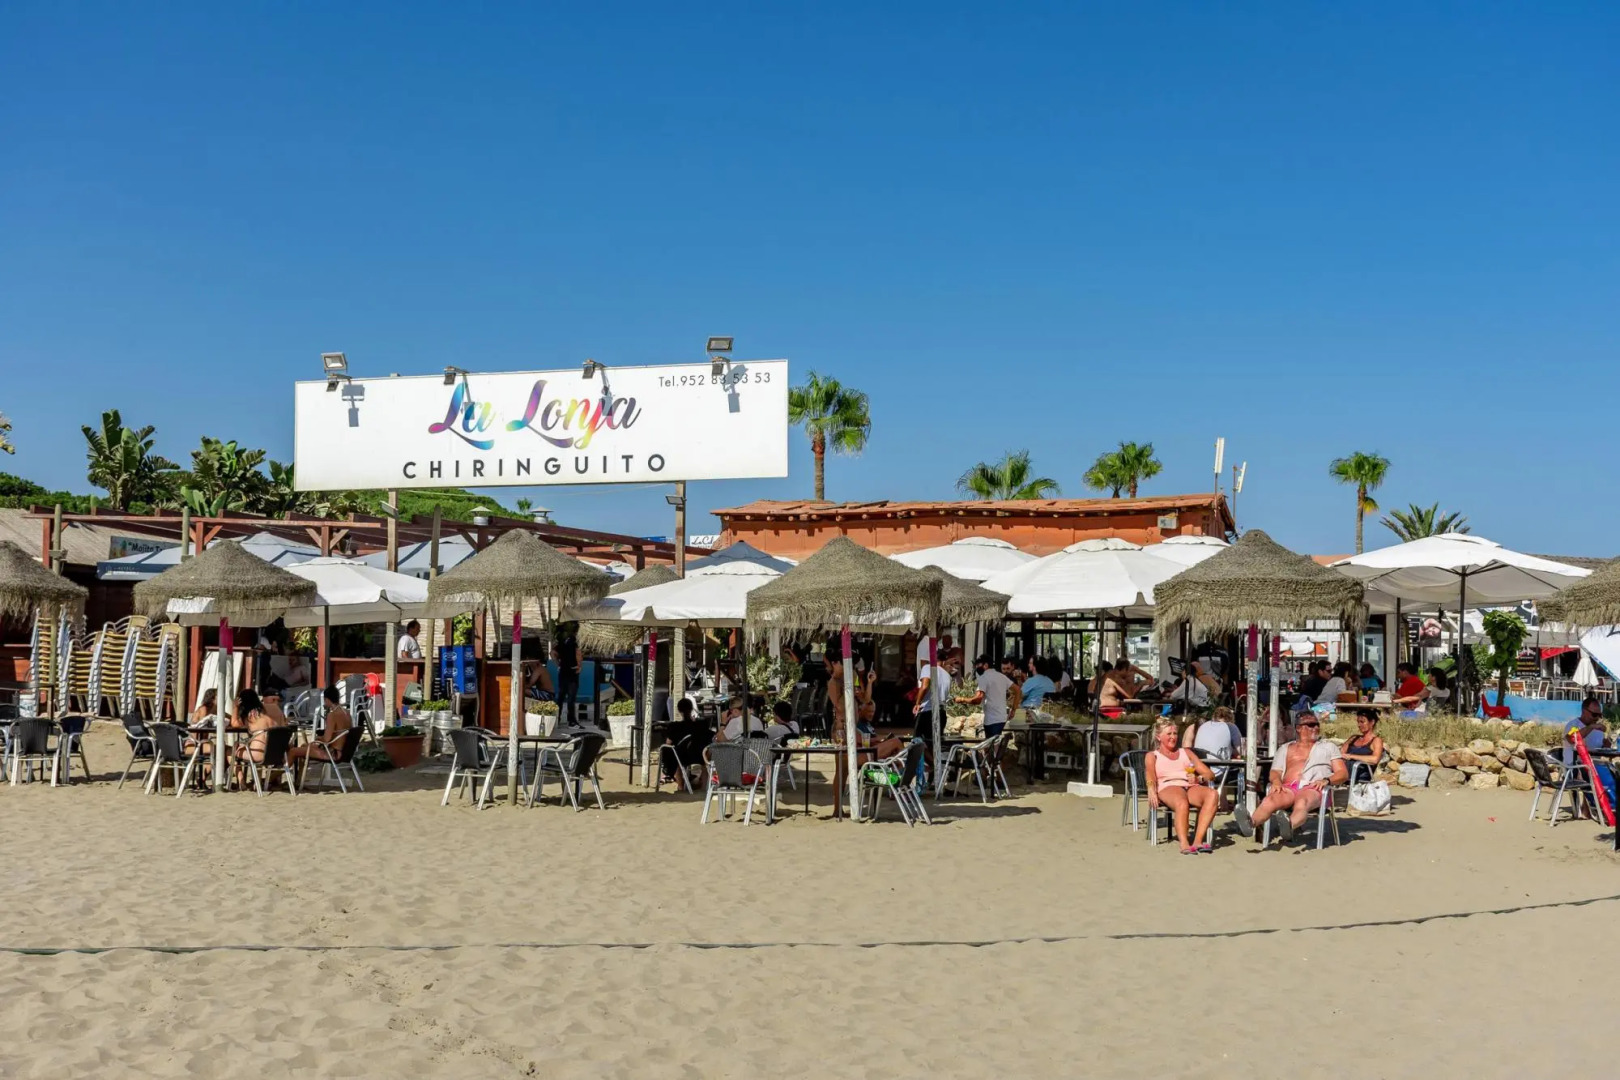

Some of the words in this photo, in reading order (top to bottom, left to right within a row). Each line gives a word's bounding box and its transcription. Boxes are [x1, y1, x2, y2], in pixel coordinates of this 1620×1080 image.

[711, 374, 726, 385] 83
[733, 373, 749, 384] 53
[754, 372, 771, 384] 53
[428, 382, 497, 450] La
[506, 379, 642, 450] Lonja
[402, 453, 666, 479] CHIRINGUITO
